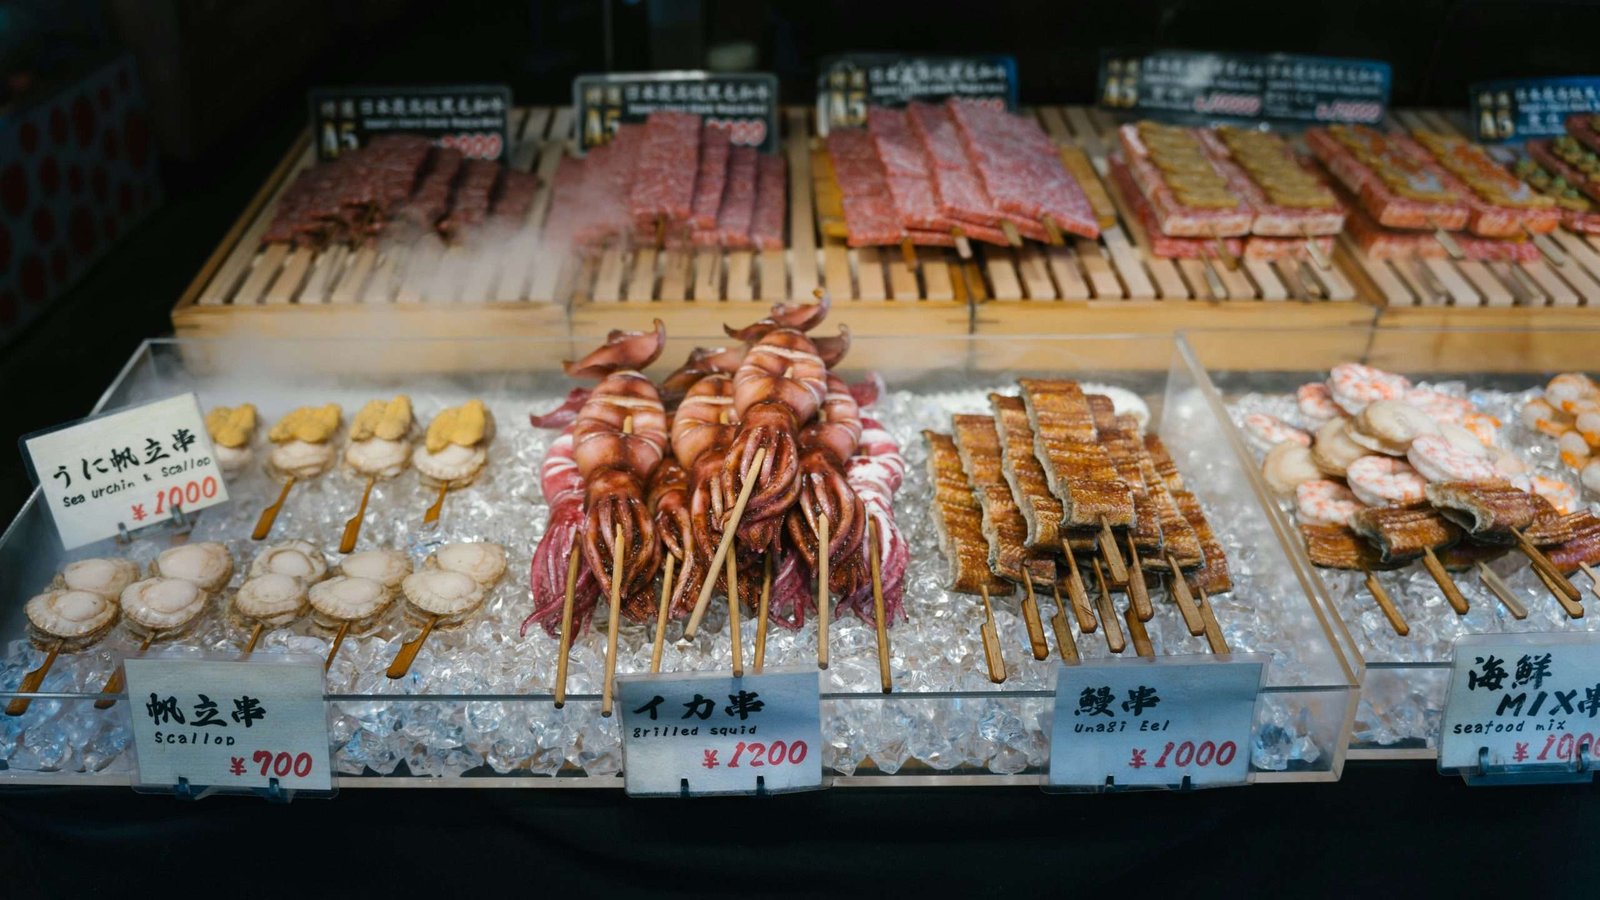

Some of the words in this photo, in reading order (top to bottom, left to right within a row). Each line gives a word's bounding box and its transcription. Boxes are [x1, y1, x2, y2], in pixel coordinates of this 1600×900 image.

[54, 428, 195, 488] うに帆立串
[63, 494, 86, 508] Sea
[1468, 653, 1552, 691] 海鮮
[146, 693, 266, 728] 帆立串
[633, 690, 765, 720] イカ串
[1073, 685, 1160, 717] 鰻串
[633, 726, 698, 738] grilled
[710, 726, 757, 737] squid
[1074, 721, 1126, 733] Unagi
[1139, 720, 1170, 732] Eel
[1453, 720, 1525, 734] seafood
[1535, 719, 1566, 731] mix
